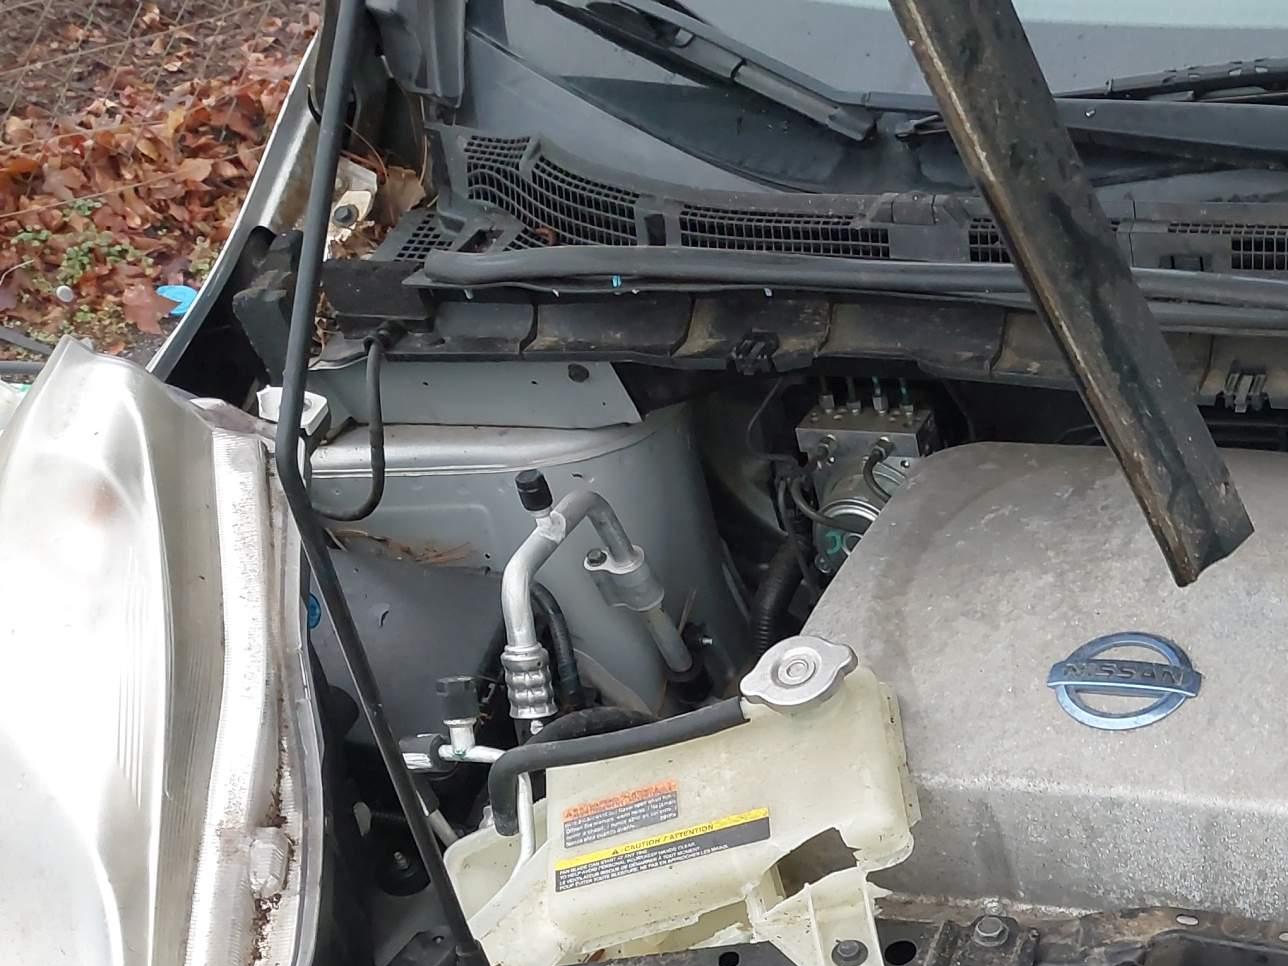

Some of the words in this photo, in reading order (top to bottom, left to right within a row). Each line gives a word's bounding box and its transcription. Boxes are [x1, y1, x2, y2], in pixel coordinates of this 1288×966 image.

[1063, 662, 1185, 686] NISSAN
[623, 837, 660, 851] CAUTION
[669, 823, 713, 839] ATTENTION
